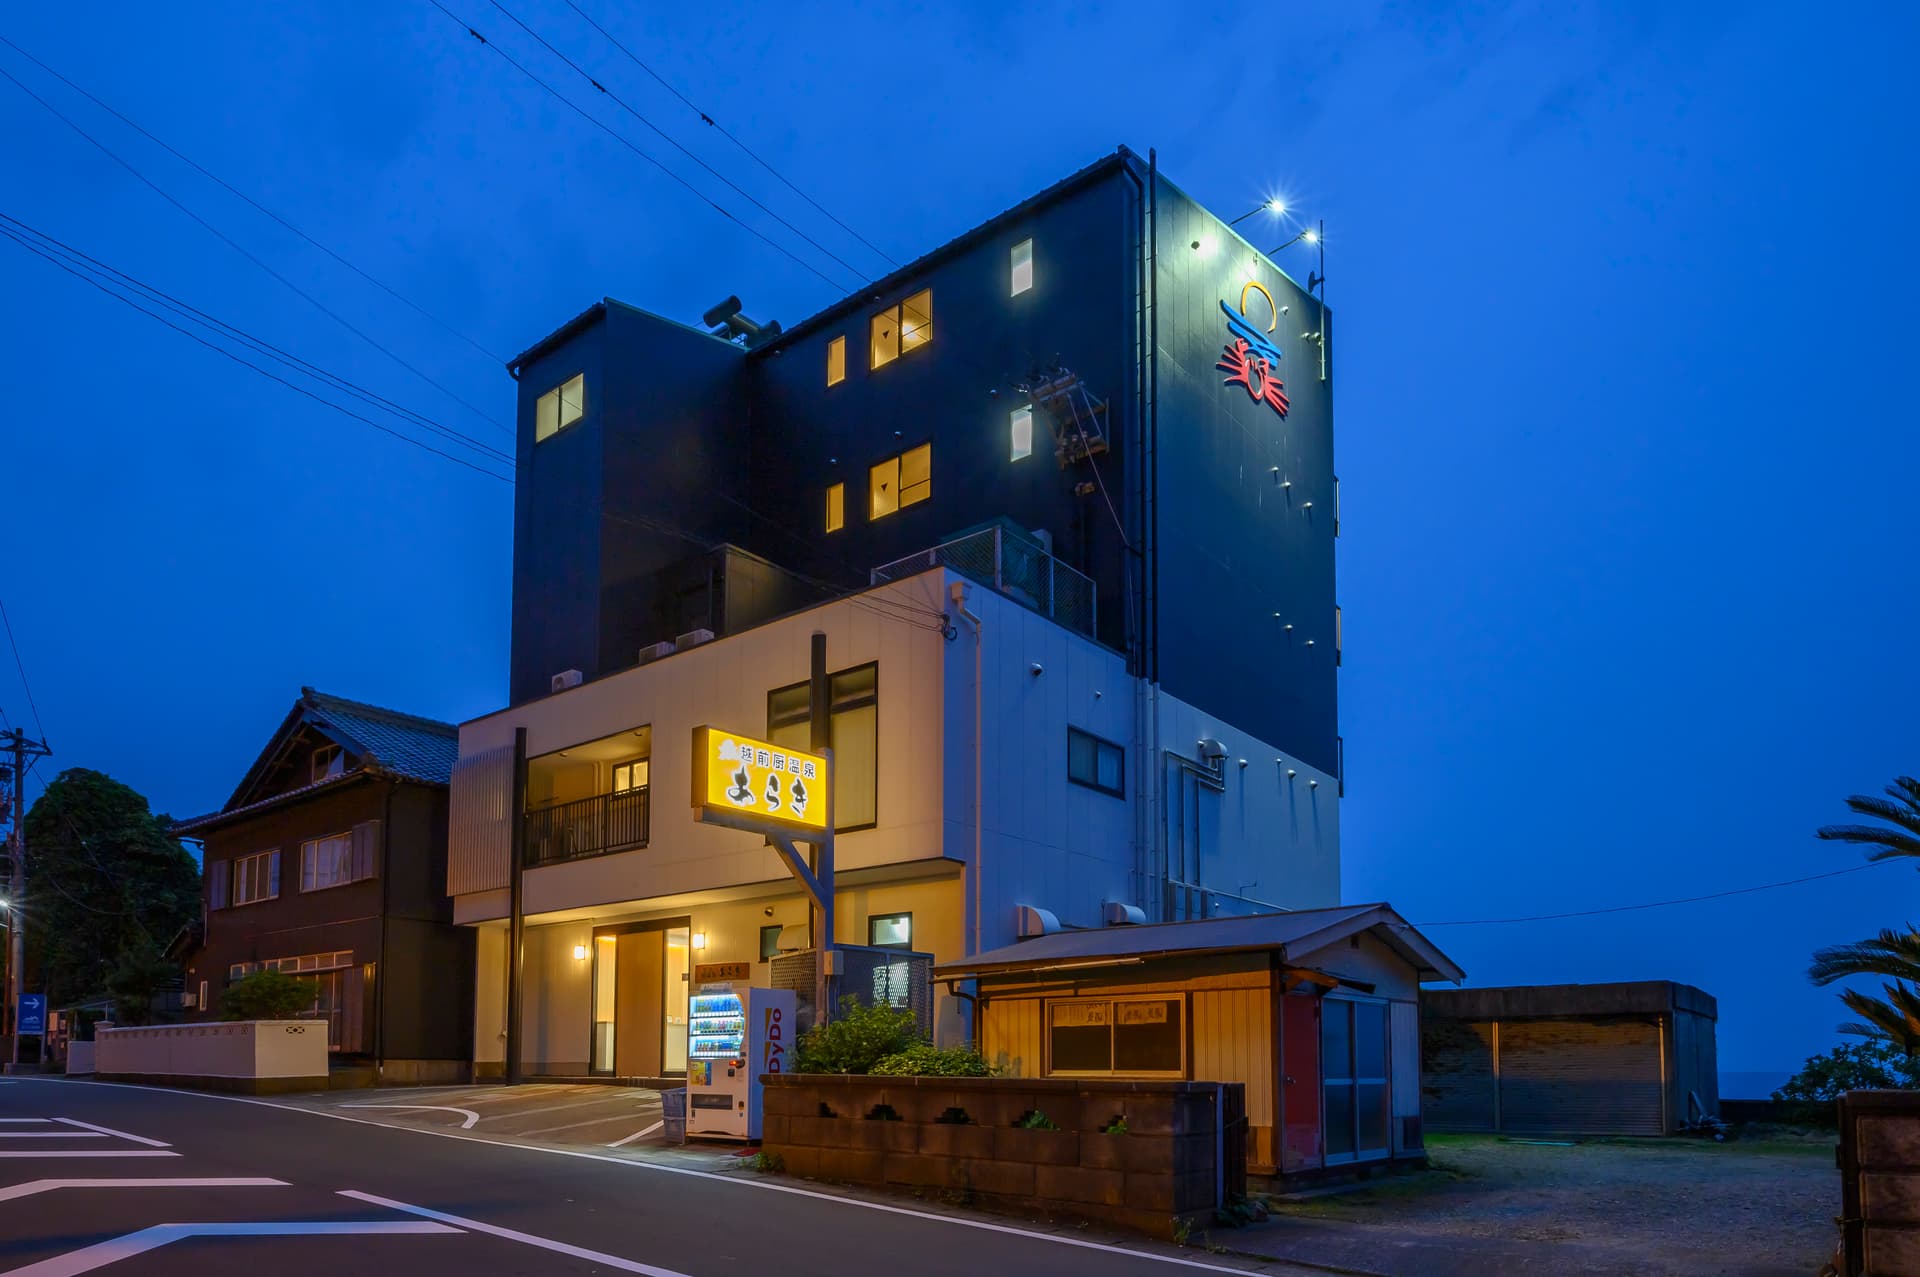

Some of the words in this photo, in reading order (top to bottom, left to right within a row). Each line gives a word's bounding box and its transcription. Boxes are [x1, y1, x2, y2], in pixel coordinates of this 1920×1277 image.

[740, 745, 816, 778] 越前厨温泉
